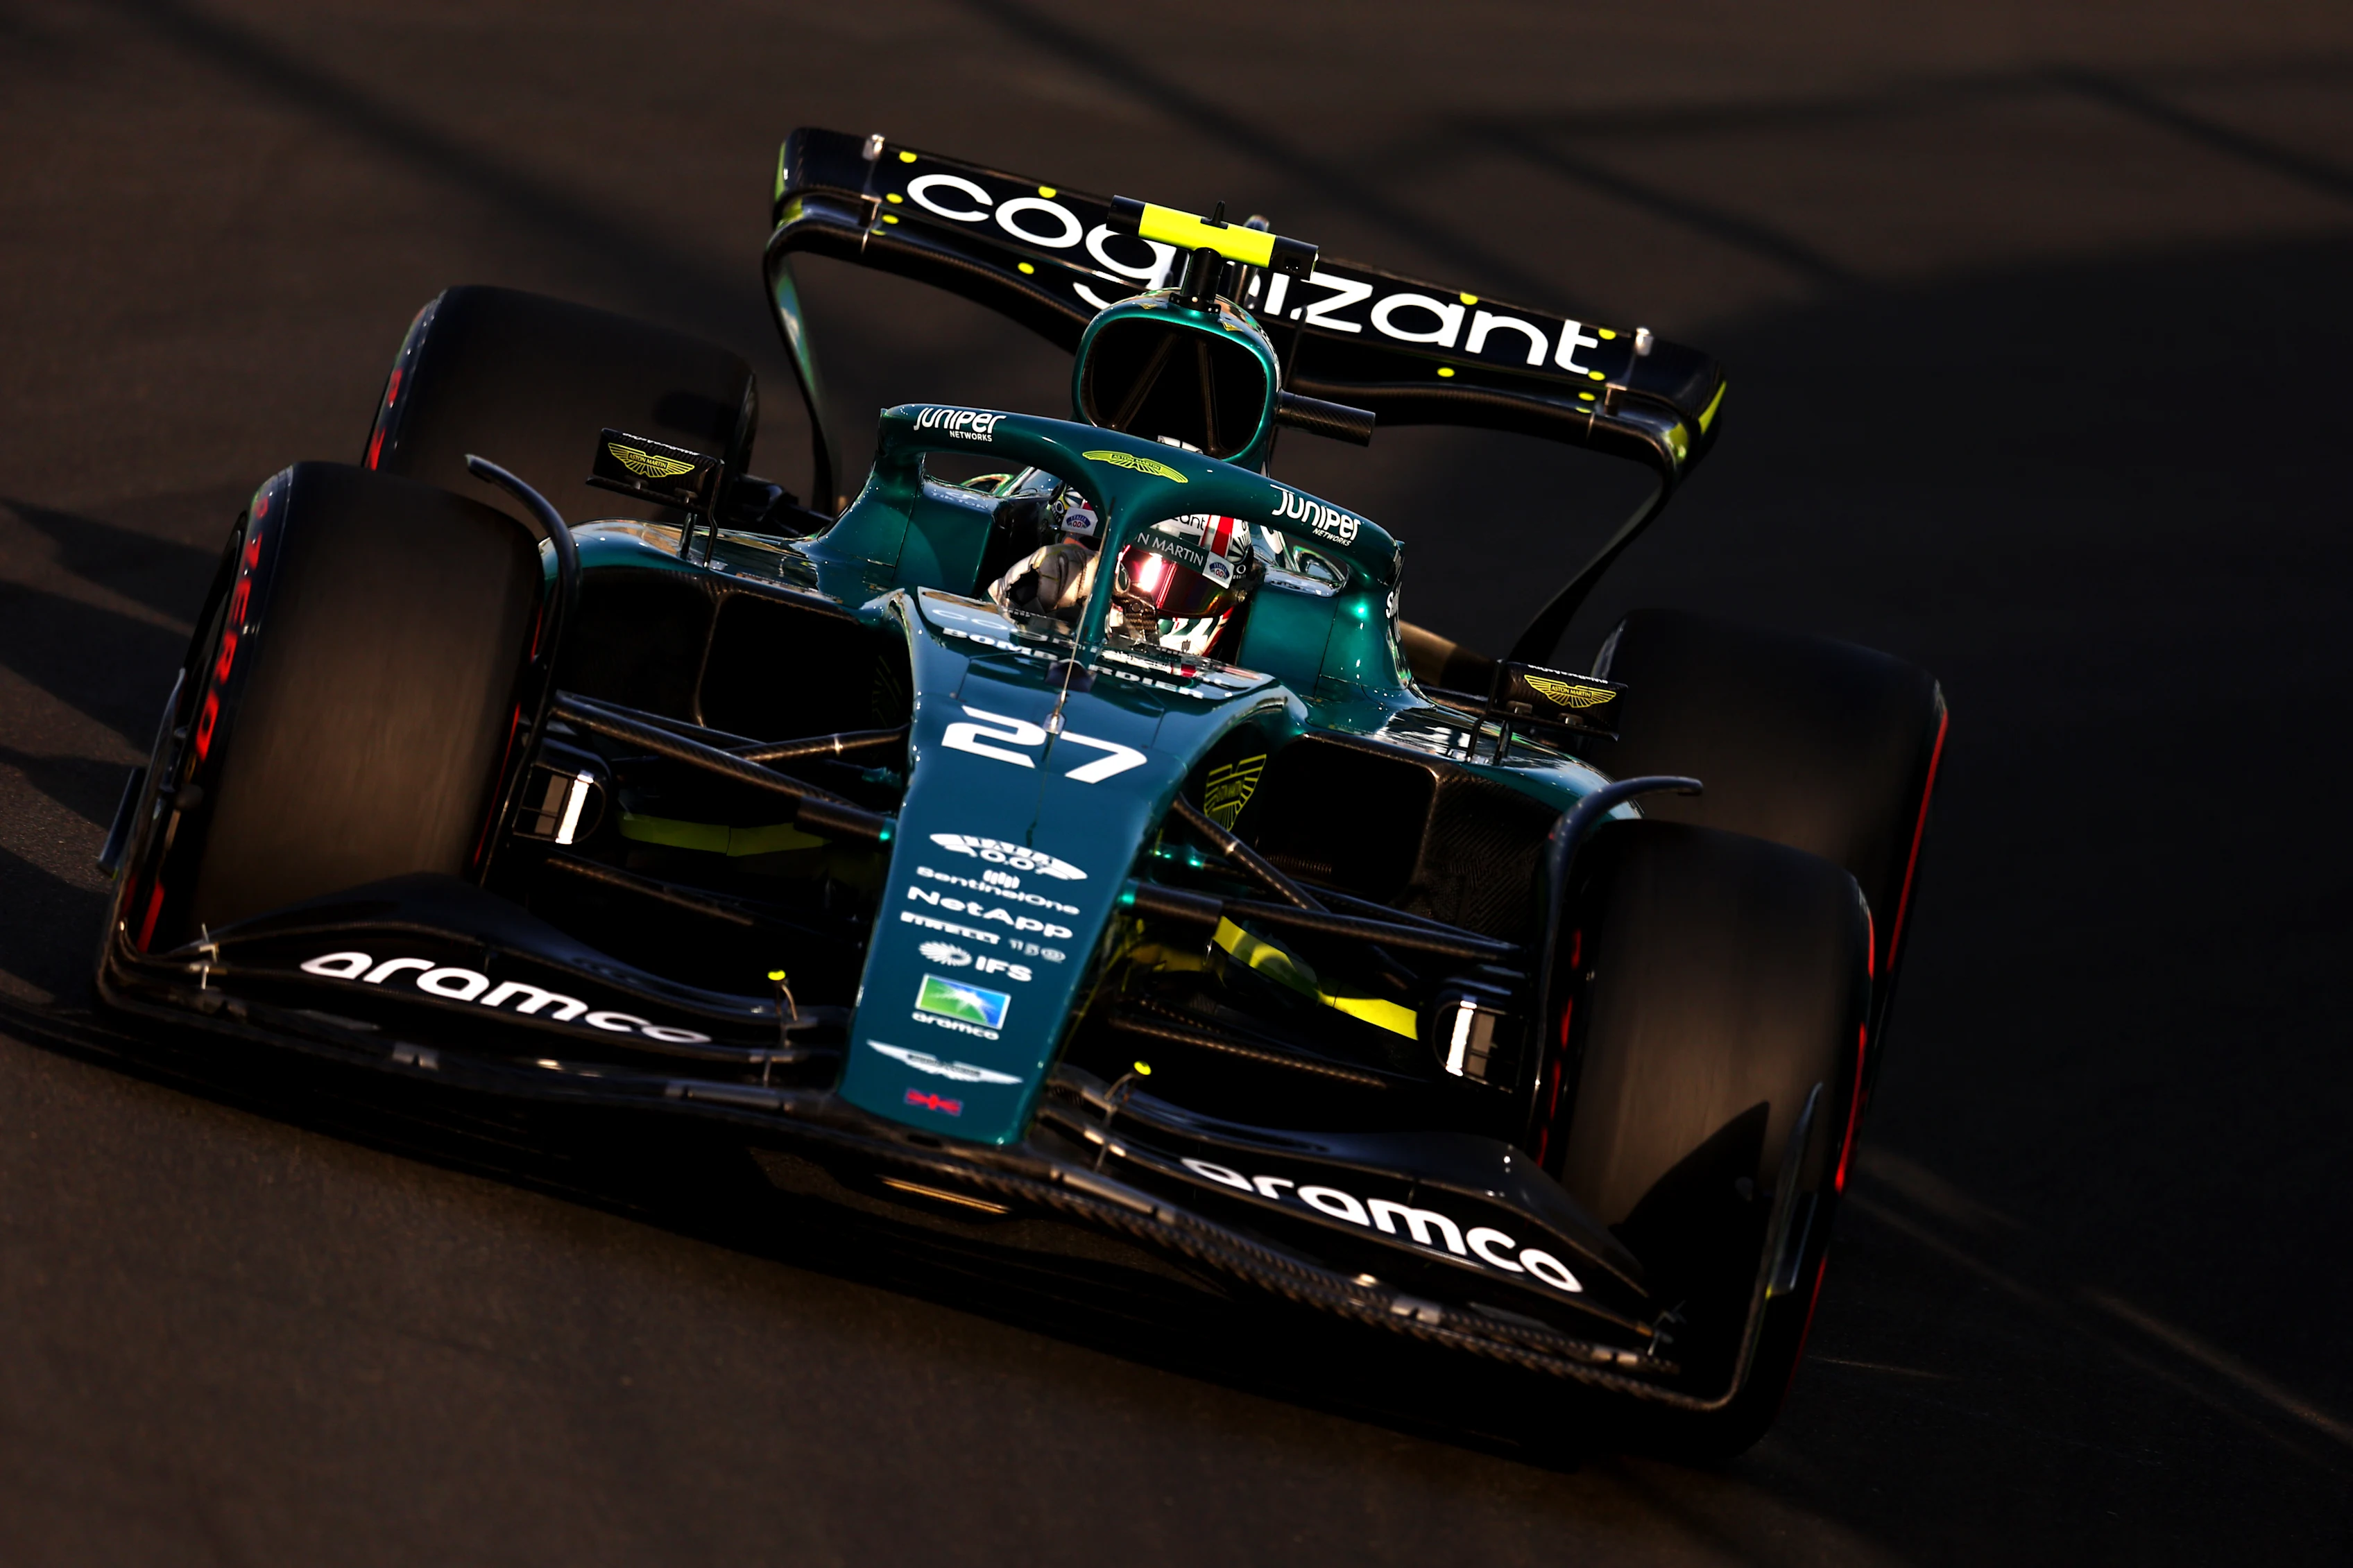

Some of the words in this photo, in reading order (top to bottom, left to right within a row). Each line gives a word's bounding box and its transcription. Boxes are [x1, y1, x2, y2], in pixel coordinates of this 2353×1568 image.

[907, 173, 1599, 375] cogizant
[949, 430, 993, 442] NETWORKS
[628, 454, 647, 463] ASTON
[646, 458, 667, 469] MARTIN
[1112, 454, 1135, 463] ASTON
[1135, 458, 1161, 471] MARTIN
[1152, 536, 1204, 567] MARTIN
[1312, 528, 1352, 546] NETWORKS
[942, 627, 1205, 700] BOMBRDIER
[1550, 684, 1570, 694] ASTON
[1570, 688, 1592, 698] MARTIN
[941, 705, 1148, 784] 27
[916, 865, 1081, 915] SentinelOne
[907, 886, 1073, 939] NetApp
[975, 955, 1033, 982] IFS
[300, 951, 712, 1043] aramco
[911, 1011, 1000, 1040] aramco
[1181, 1157, 1583, 1293] aramco
